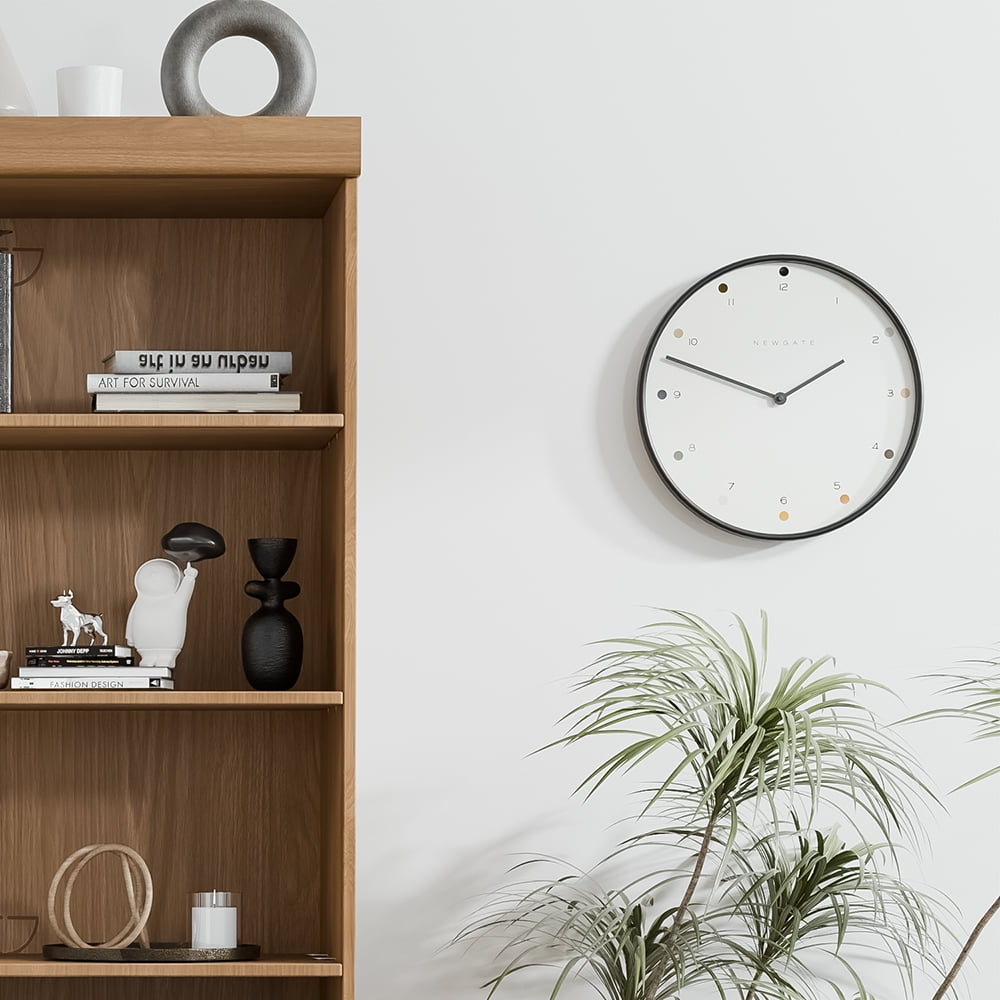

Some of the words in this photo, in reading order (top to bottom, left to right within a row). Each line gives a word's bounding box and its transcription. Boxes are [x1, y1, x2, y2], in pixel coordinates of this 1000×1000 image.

[778, 283, 789, 292] 12
[727, 298, 735, 306] 11
[688, 338, 698, 346] 10
[871, 336, 880, 345] 2
[98, 377, 119, 388] ART
[123, 376, 146, 388] FOR
[149, 376, 200, 388] SURVIVAL
[673, 390, 682, 399] 9
[887, 389, 895, 398] 3
[688, 443, 696, 452] 8
[871, 442, 879, 451] 4
[727, 482, 736, 491] 7
[833, 481, 841, 490] 5
[779, 496, 788, 505] 6
[50, 681, 89, 689] FASHION
[91, 681, 124, 689] DESIGN
